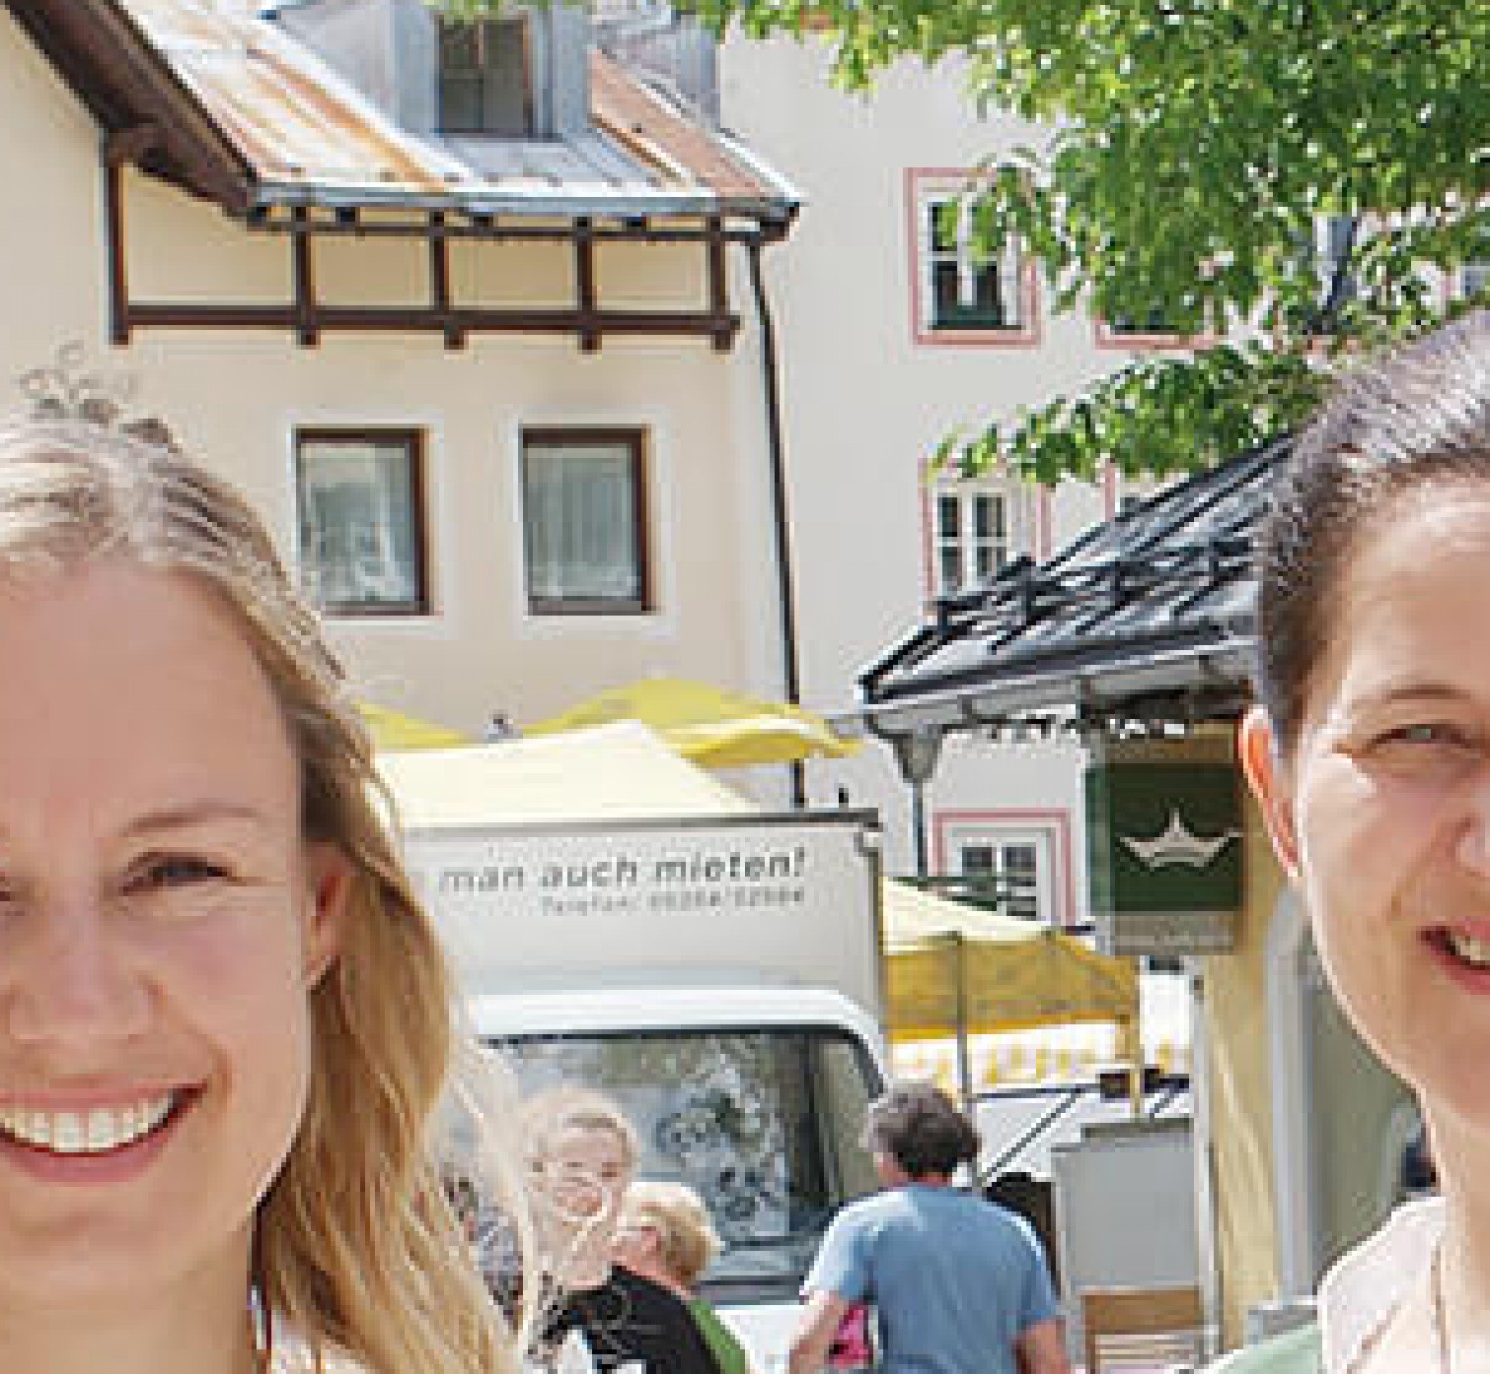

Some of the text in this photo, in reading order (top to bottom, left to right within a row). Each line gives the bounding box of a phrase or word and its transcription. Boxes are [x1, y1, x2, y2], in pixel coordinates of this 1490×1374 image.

[441, 844, 806, 892] man auch mieten!
